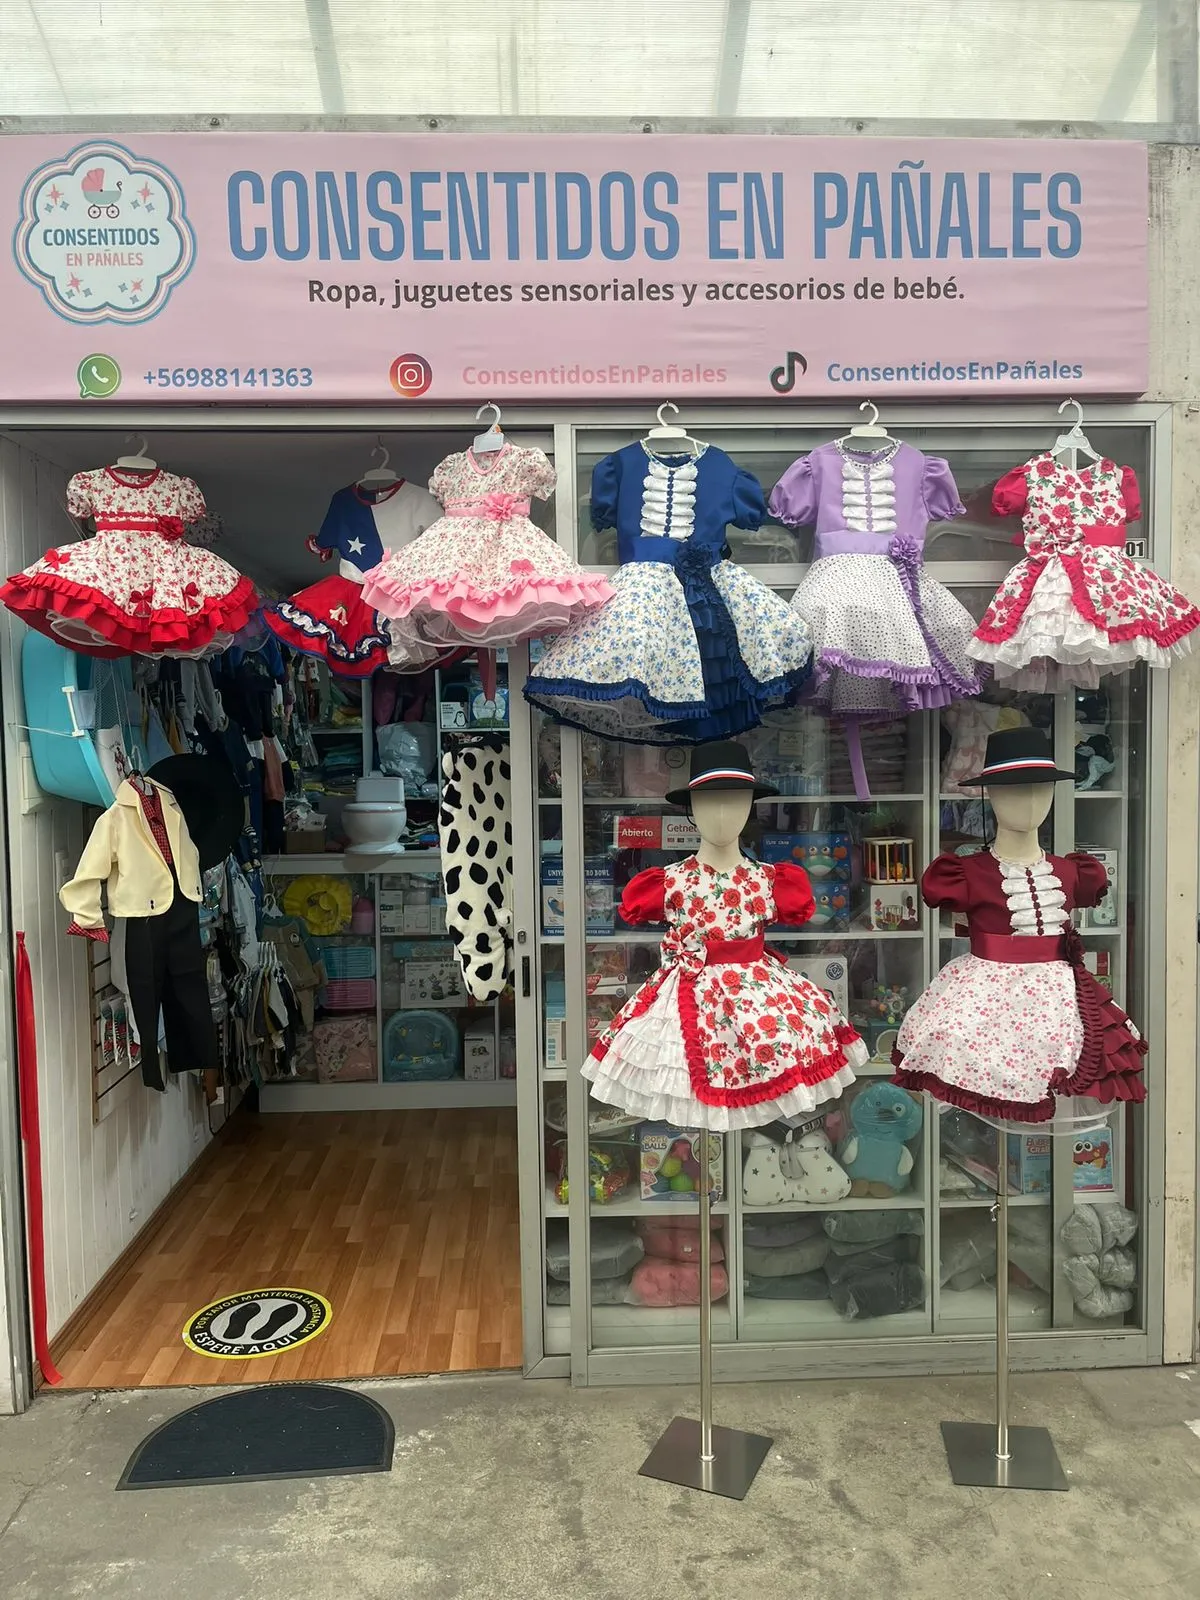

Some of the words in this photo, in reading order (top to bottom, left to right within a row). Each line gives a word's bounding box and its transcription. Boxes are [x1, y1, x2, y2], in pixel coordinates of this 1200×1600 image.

[228, 171, 680, 262] CONSENTIDOS
[708, 172, 785, 261] EN
[814, 160, 1082, 260] PAÑALES
[43, 228, 159, 248] CONSENTIDOS
[66, 253, 84, 267] EN
[87, 249, 144, 267] PAÑALES
[308, 280, 387, 310] Ropa,
[392, 279, 513, 310] juguetes
[520, 278, 676, 304] sensoriales
[681, 284, 697, 309] y
[705, 277, 846, 303] accesorios
[854, 277, 885, 300] de
[893, 276, 965, 300] bebé.
[143, 368, 313, 390] +56988141363
[463, 364, 728, 386] ConsentidosEnPañales
[827, 360, 1083, 383] ConsentidosEnPañales
[1125, 541, 1144, 557] 01
[621, 828, 654, 837] Abierto
[666, 823, 698, 833] Getnet
[644, 1142, 668, 1150] BALLS
[241, 1291, 303, 1301] MANTENGA
[302, 1297, 314, 1305] LA
[205, 1299, 239, 1316] FAVOR
[195, 1316, 210, 1329] POR
[300, 1303, 322, 1333] DISTANCIA
[194, 1332, 243, 1354] ESPERE
